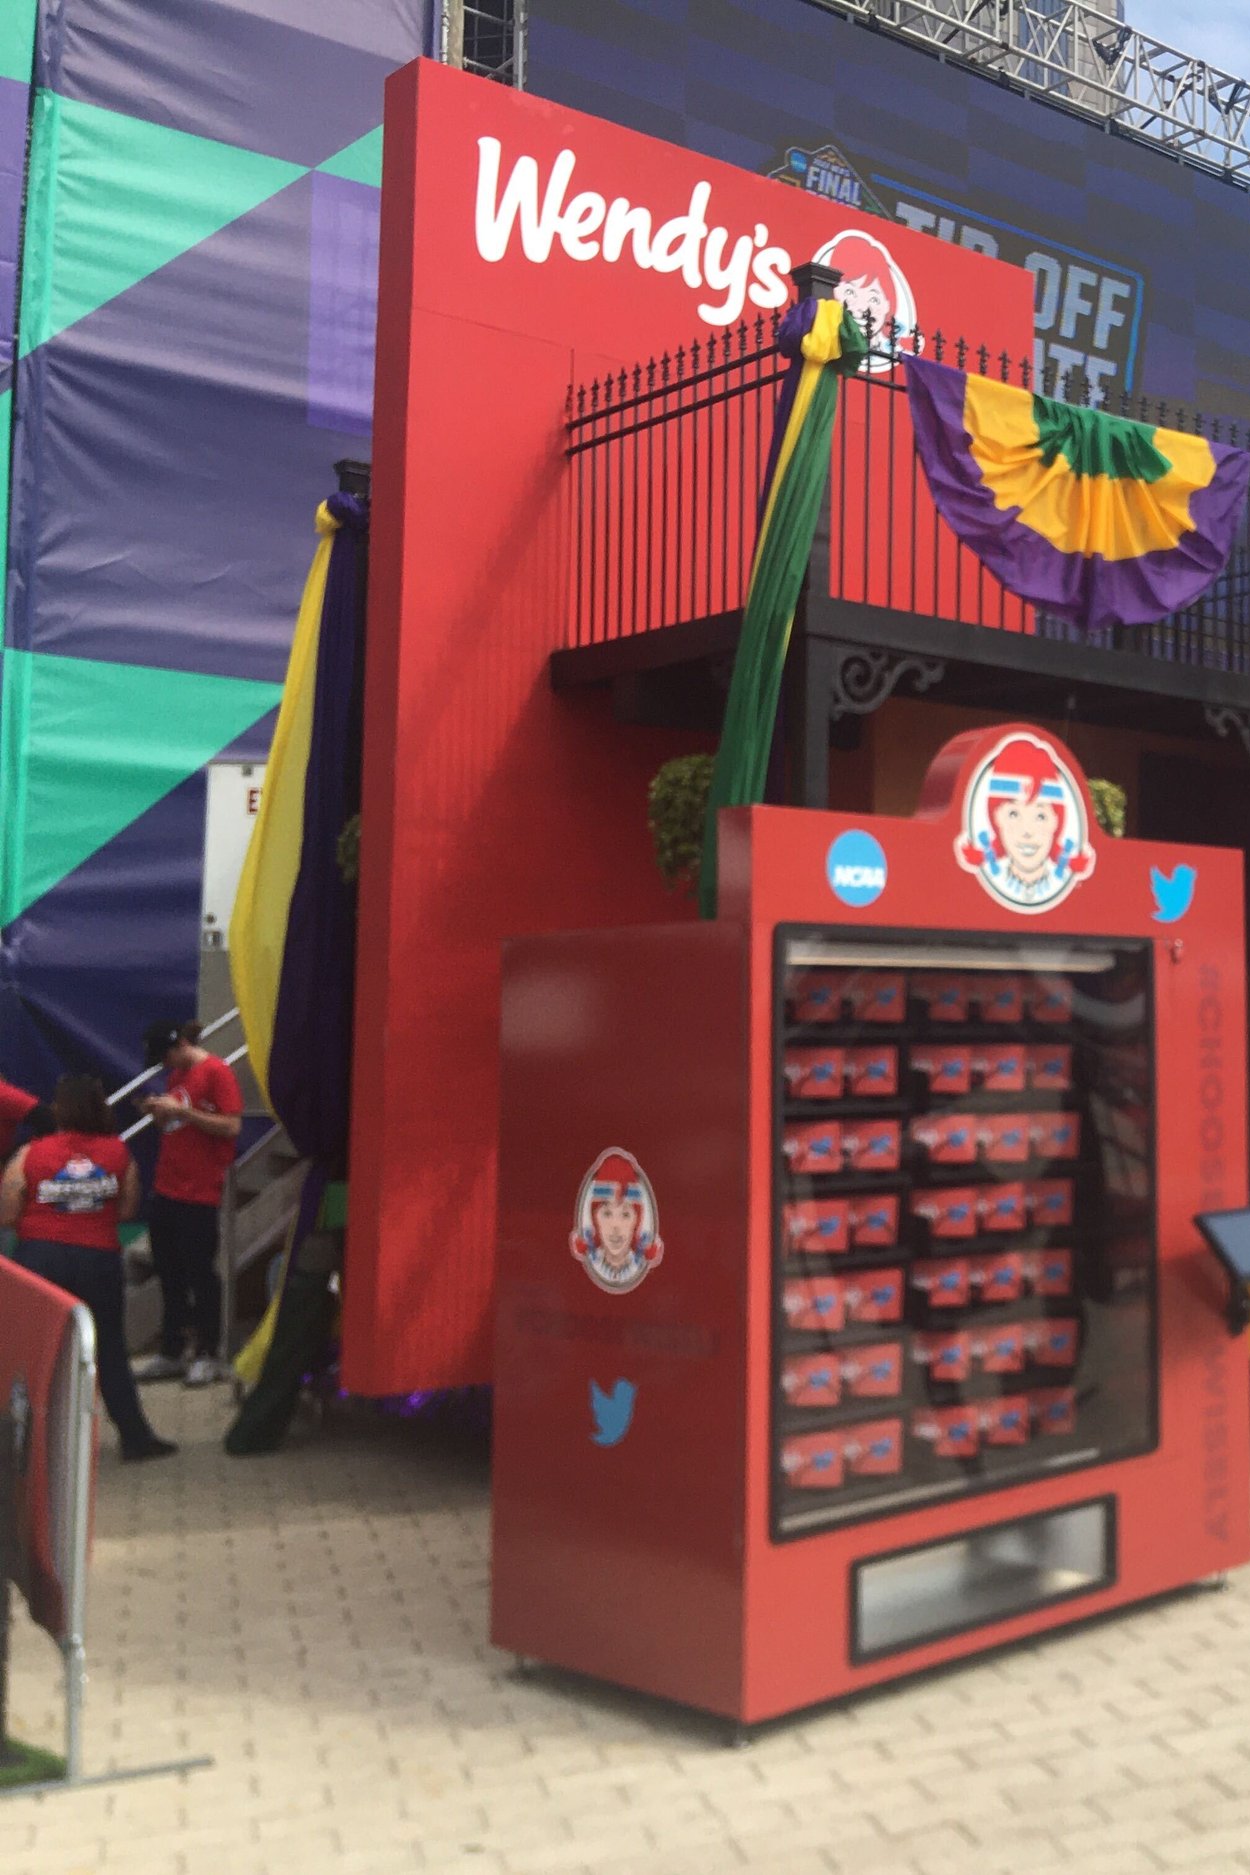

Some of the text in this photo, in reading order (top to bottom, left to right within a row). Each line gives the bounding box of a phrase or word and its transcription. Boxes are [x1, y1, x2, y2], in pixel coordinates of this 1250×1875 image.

[475, 136, 790, 326] Wendy's
[805, 165, 862, 206] FINAL
[1024, 251, 1131, 350] OFF
